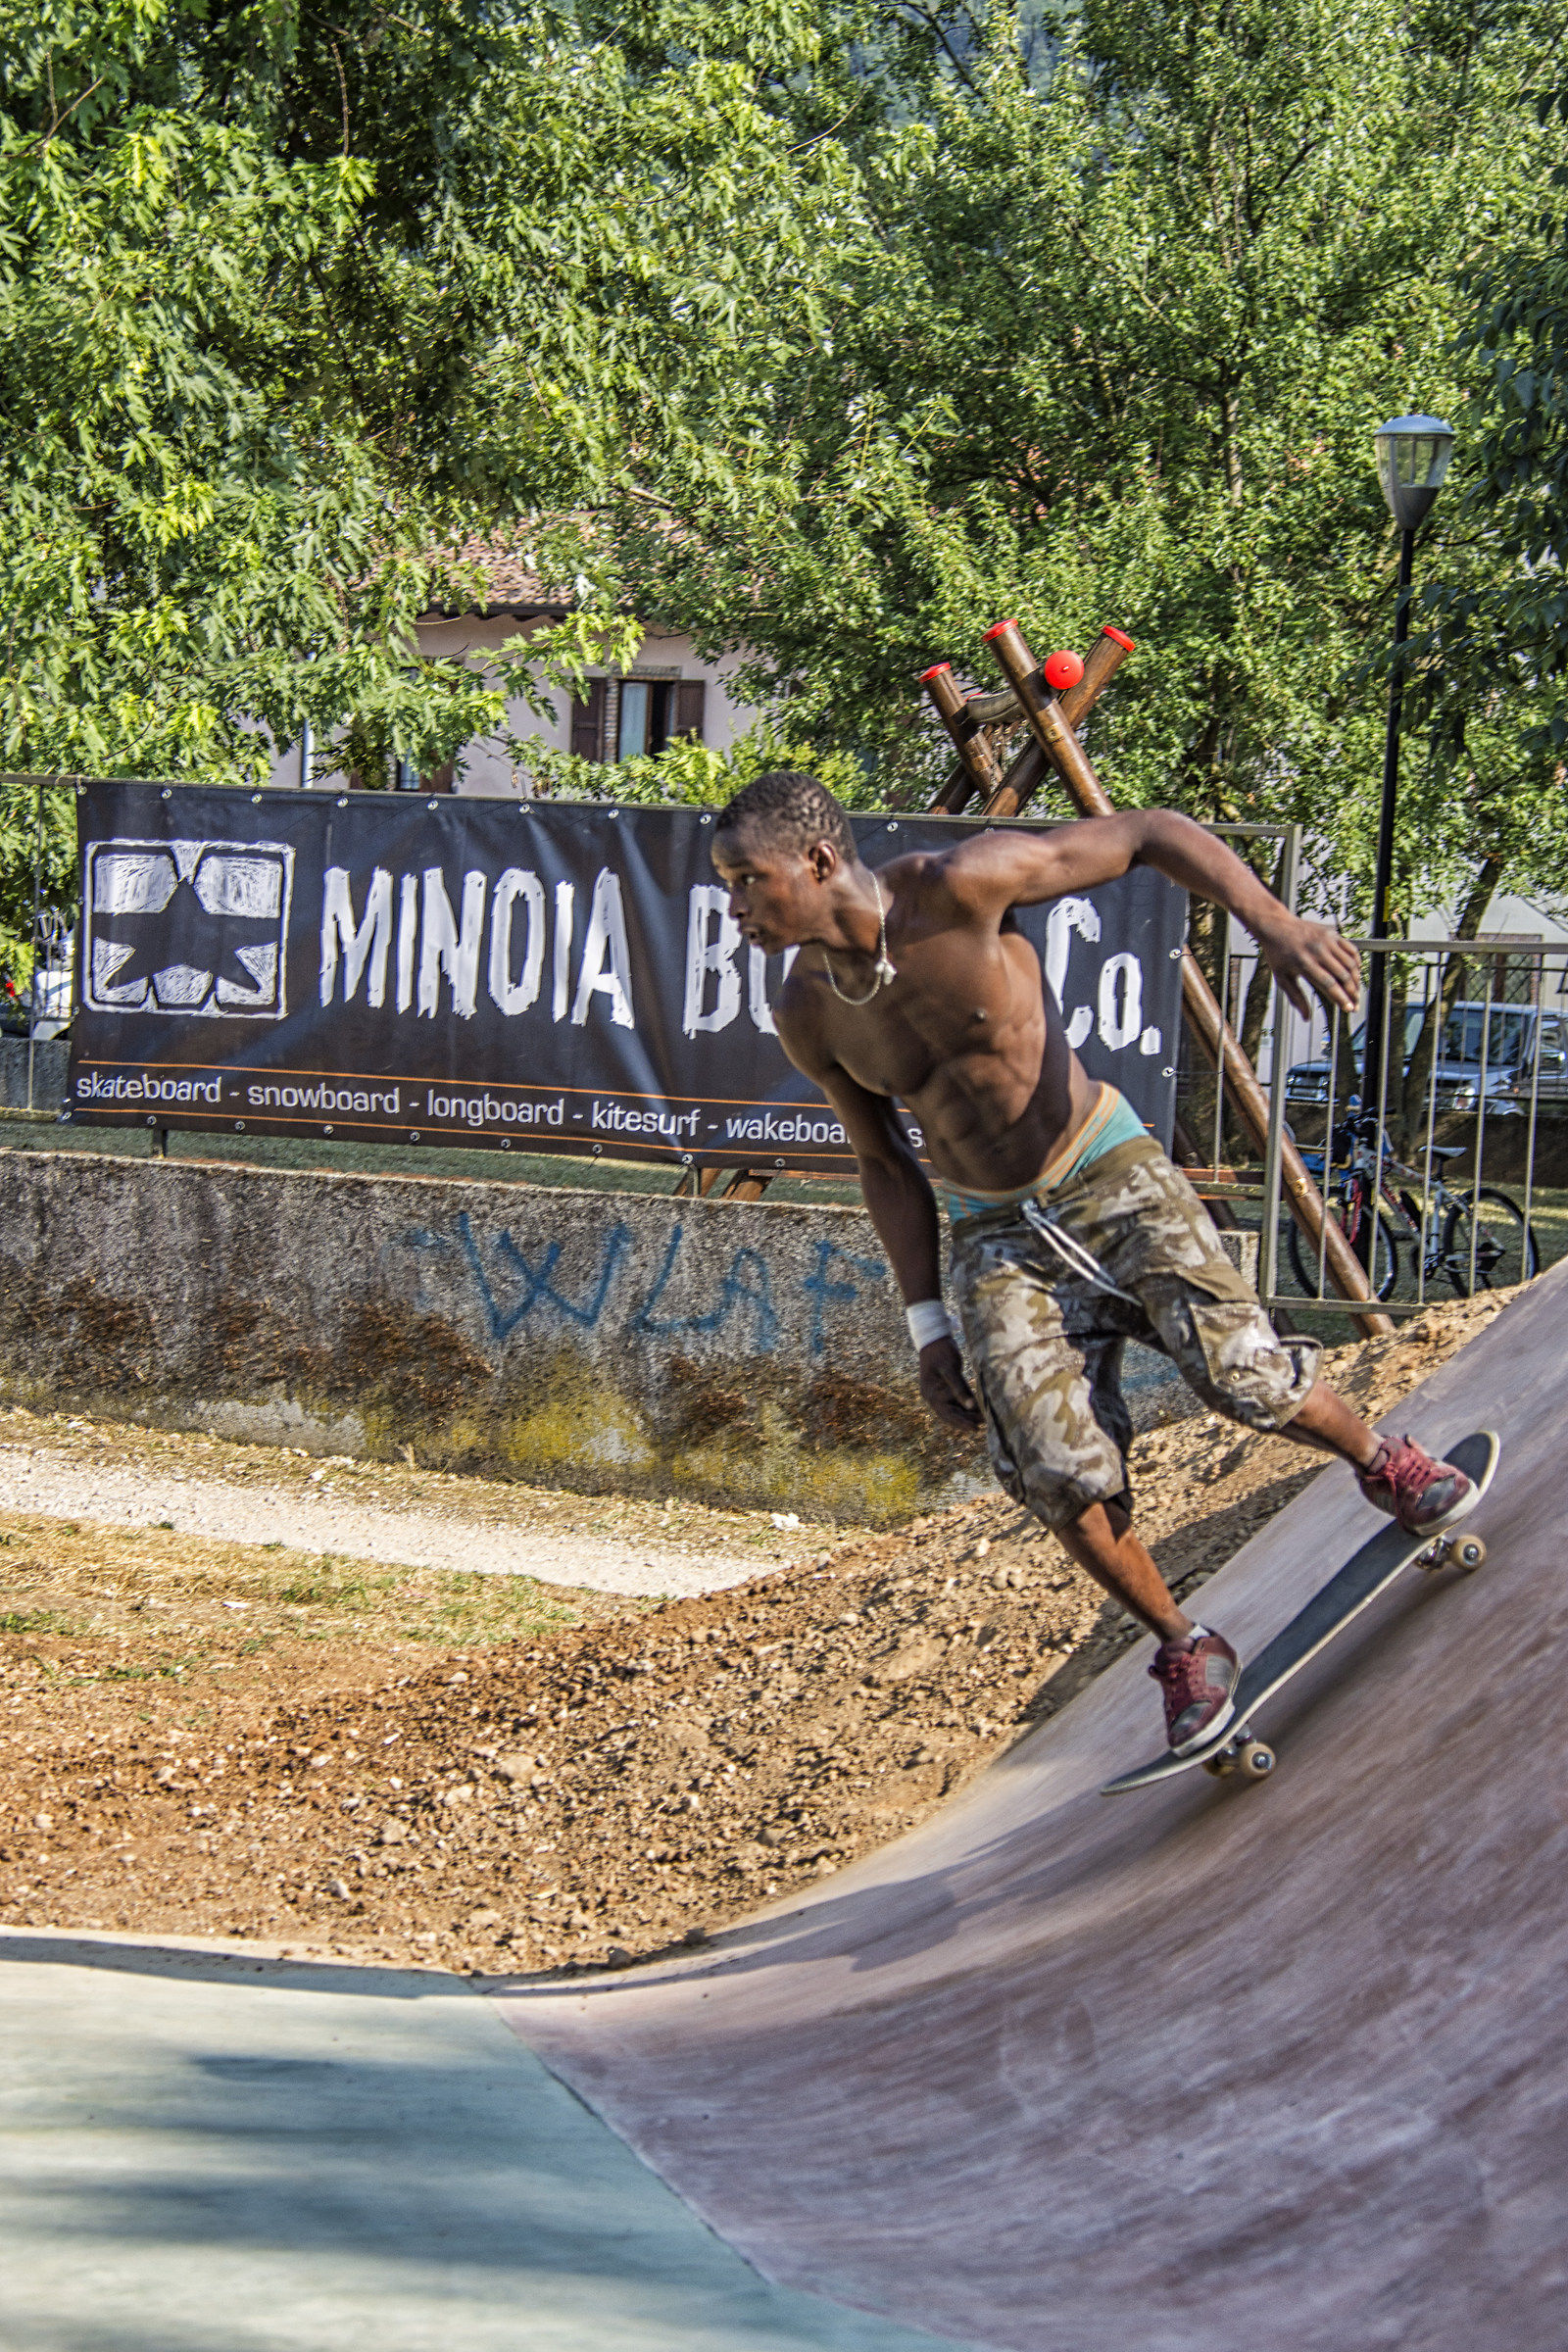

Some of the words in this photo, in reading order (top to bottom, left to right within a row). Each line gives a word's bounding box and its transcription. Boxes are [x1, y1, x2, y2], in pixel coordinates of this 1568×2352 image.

[319, 866, 634, 1029] MINOIA
[1045, 896, 1161, 1055] Co.
[76, 1071, 221, 1103] skateboard
[247, 1082, 400, 1114] snowboard
[427, 1089, 564, 1127] longboard
[592, 1101, 701, 1137] kitesurf
[725, 1112, 851, 1145] wakeboa
